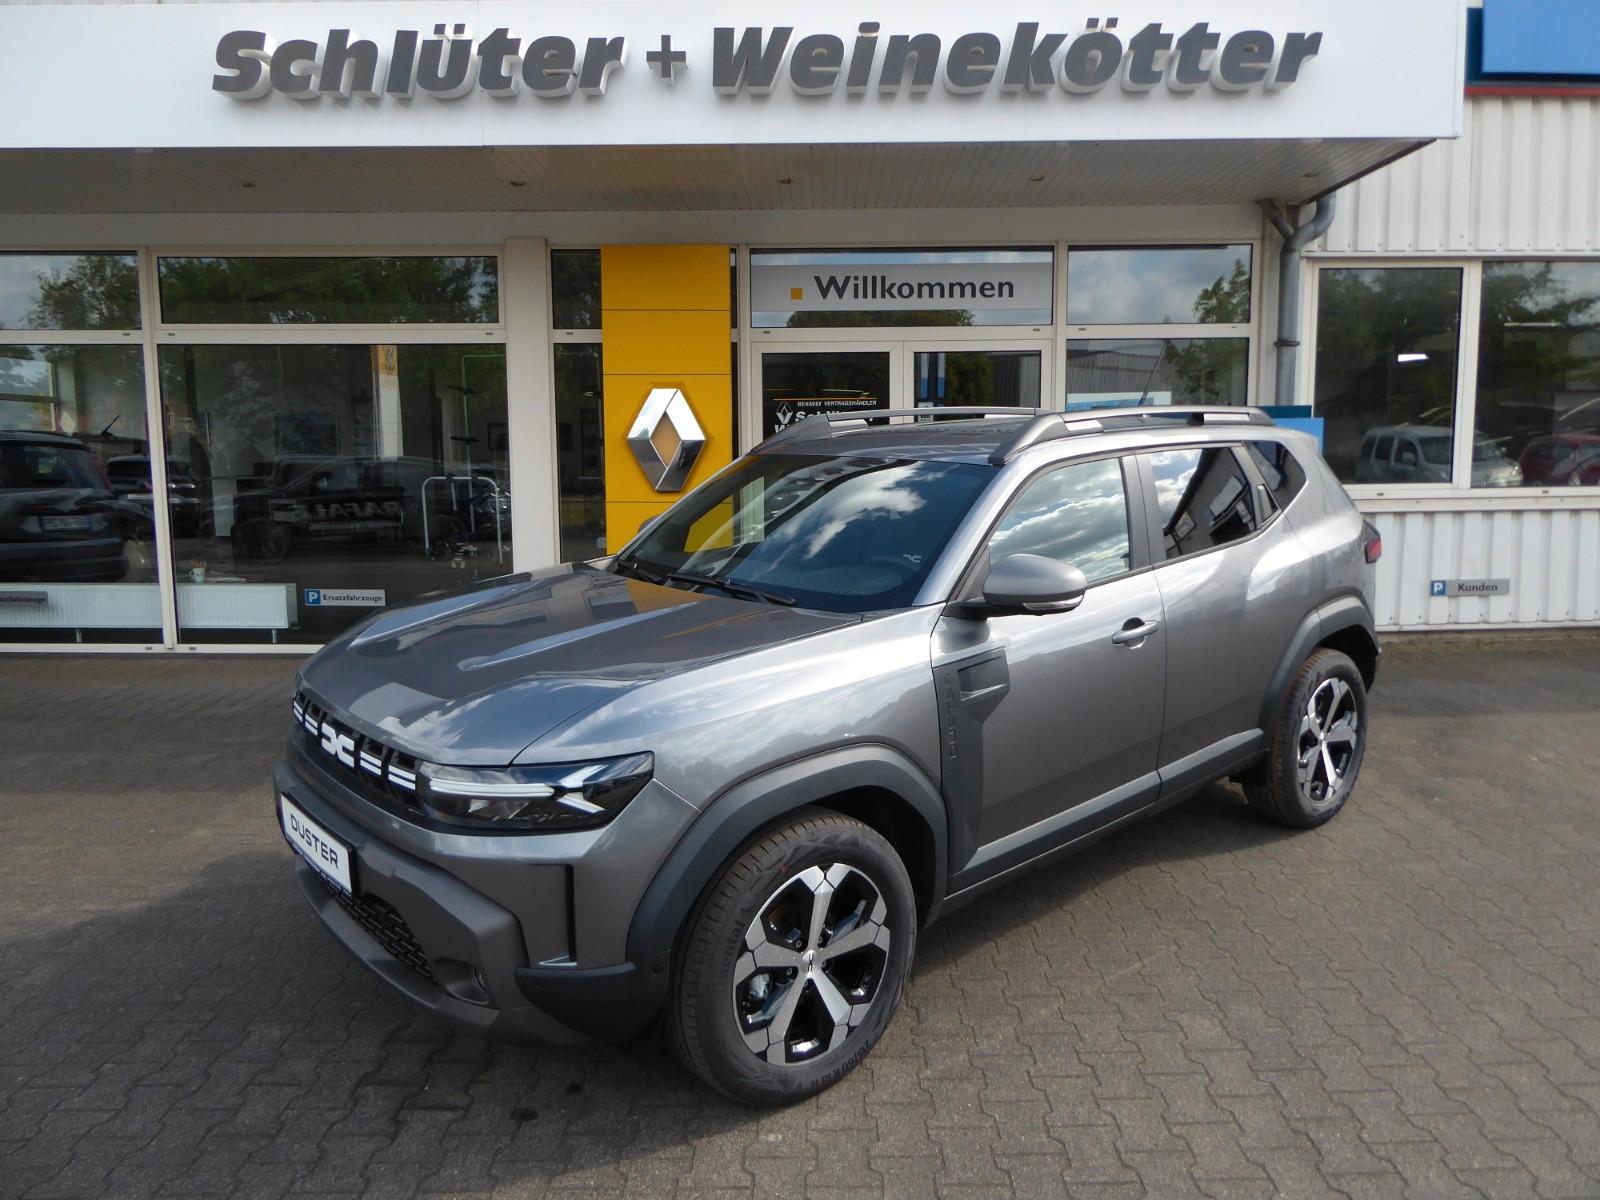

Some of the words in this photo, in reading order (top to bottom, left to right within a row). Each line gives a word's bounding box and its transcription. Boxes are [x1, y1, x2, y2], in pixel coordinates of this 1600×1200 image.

[212, 23, 627, 99] Schlüter
[646, 34, 687, 82] +
[711, 17, 1323, 96] Weinekötter
[814, 275, 1015, 300] Willkommen
[323, 593, 383, 603] Ersatzfahrzeuge
[1458, 582, 1498, 592] Kunden
[289, 812, 339, 869] DUSTER
